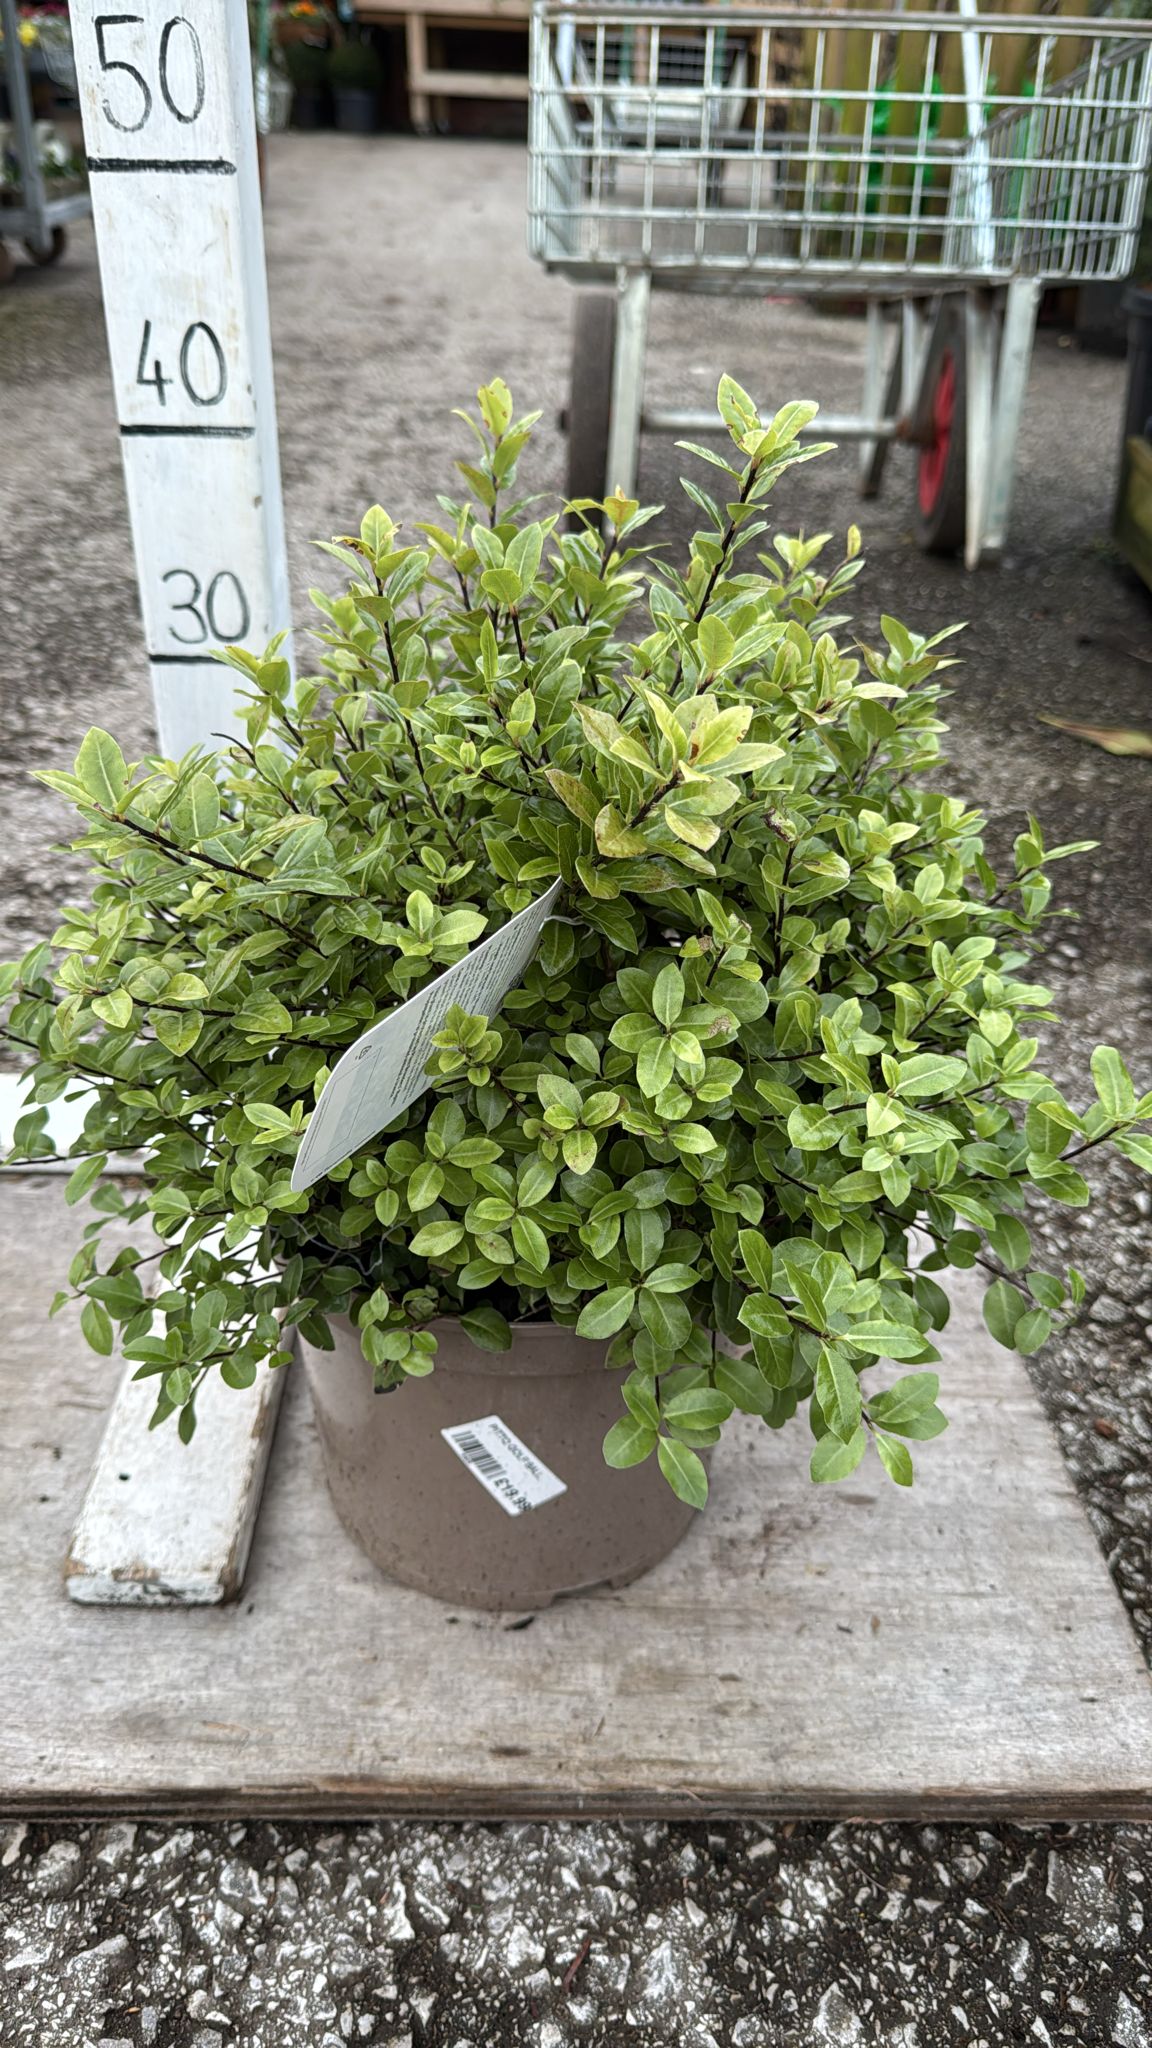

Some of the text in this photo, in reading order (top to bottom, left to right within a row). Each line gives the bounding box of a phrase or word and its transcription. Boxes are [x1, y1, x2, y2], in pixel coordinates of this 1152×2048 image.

[93, 14, 206, 134] 50
[136, 320, 226, 407] 40
[161, 568, 250, 645] 30
